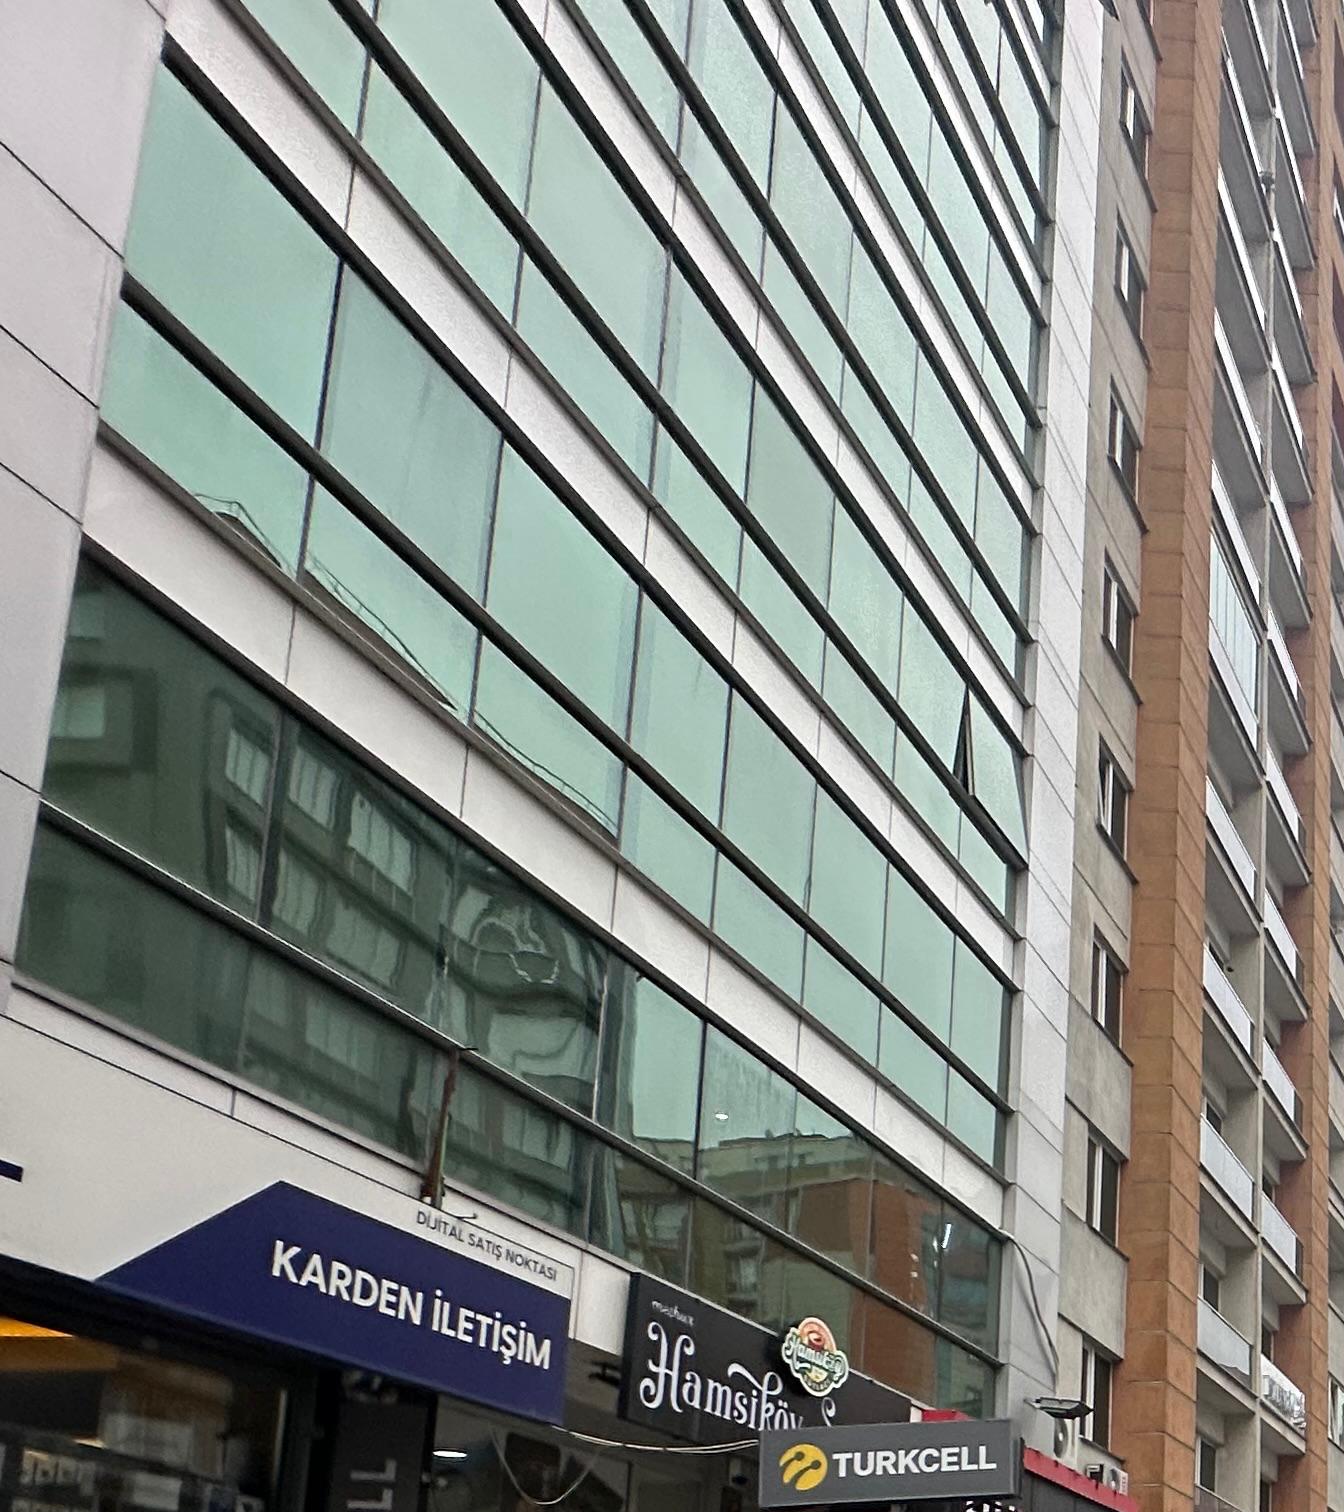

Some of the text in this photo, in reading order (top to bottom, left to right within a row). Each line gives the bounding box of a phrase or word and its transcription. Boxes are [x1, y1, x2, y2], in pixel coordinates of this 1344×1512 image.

[469, 1231, 502, 1262] SATIŞ
[504, 1250, 557, 1282] NOKTASI
[271, 1239, 551, 1370] KARDEN İLETİŞİM
[832, 1445, 997, 1478] TURKCELL
